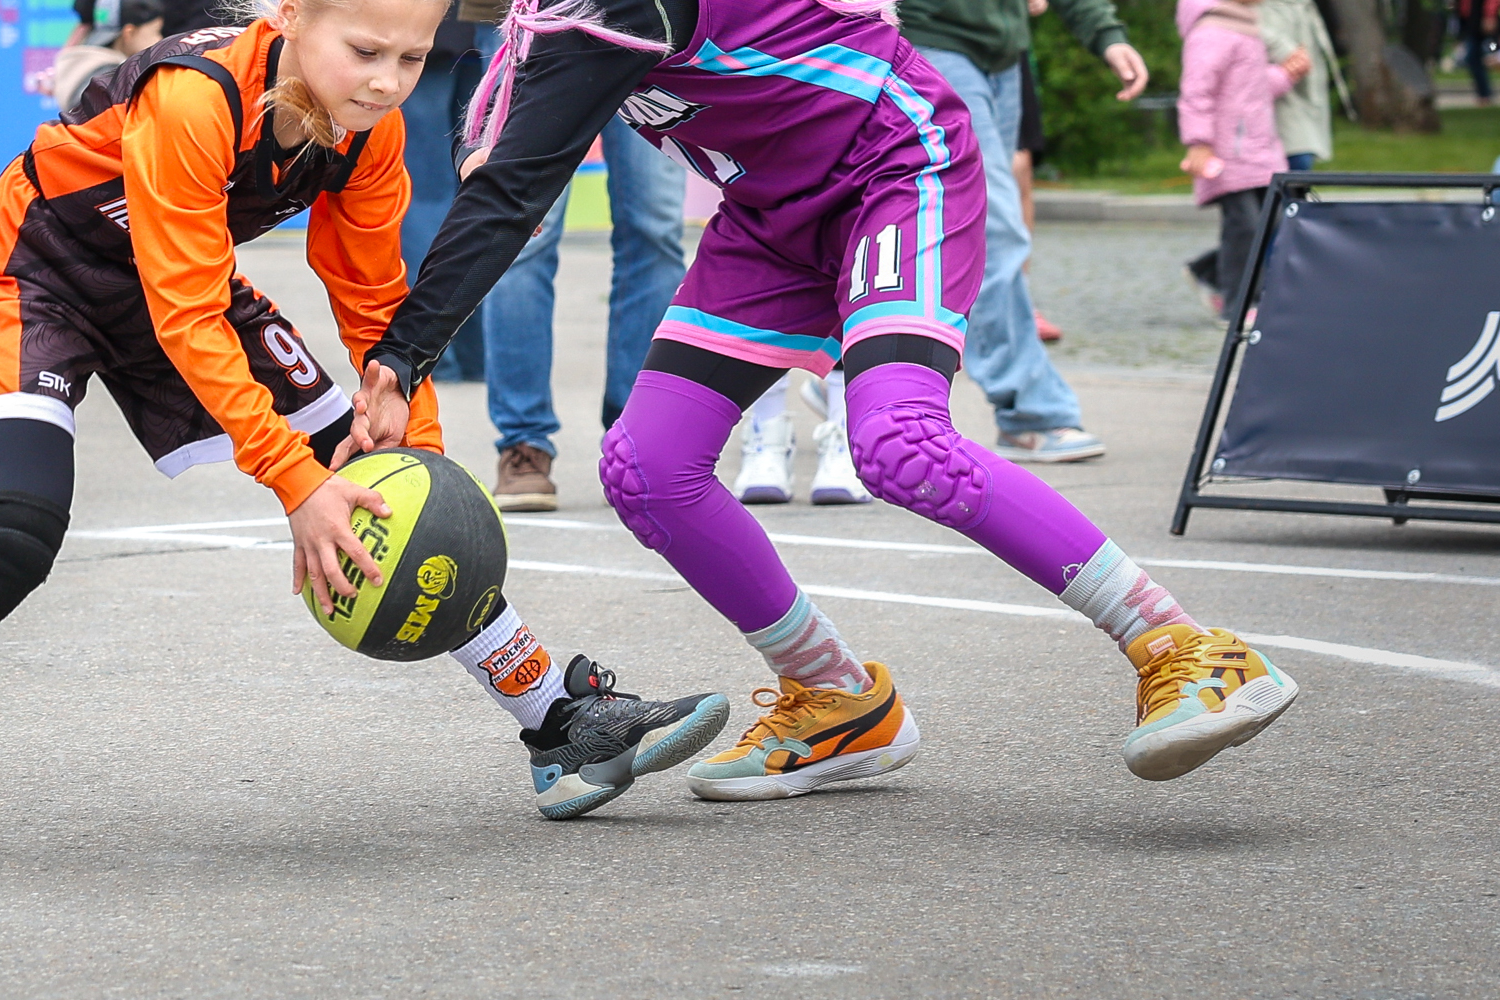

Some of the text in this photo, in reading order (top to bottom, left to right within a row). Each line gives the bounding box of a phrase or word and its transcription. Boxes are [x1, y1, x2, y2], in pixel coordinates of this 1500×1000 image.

[848, 225, 904, 304] 11
[261, 321, 320, 389] 9
[37, 370, 72, 398] STK
[492, 632, 531, 671] МОСКВА
